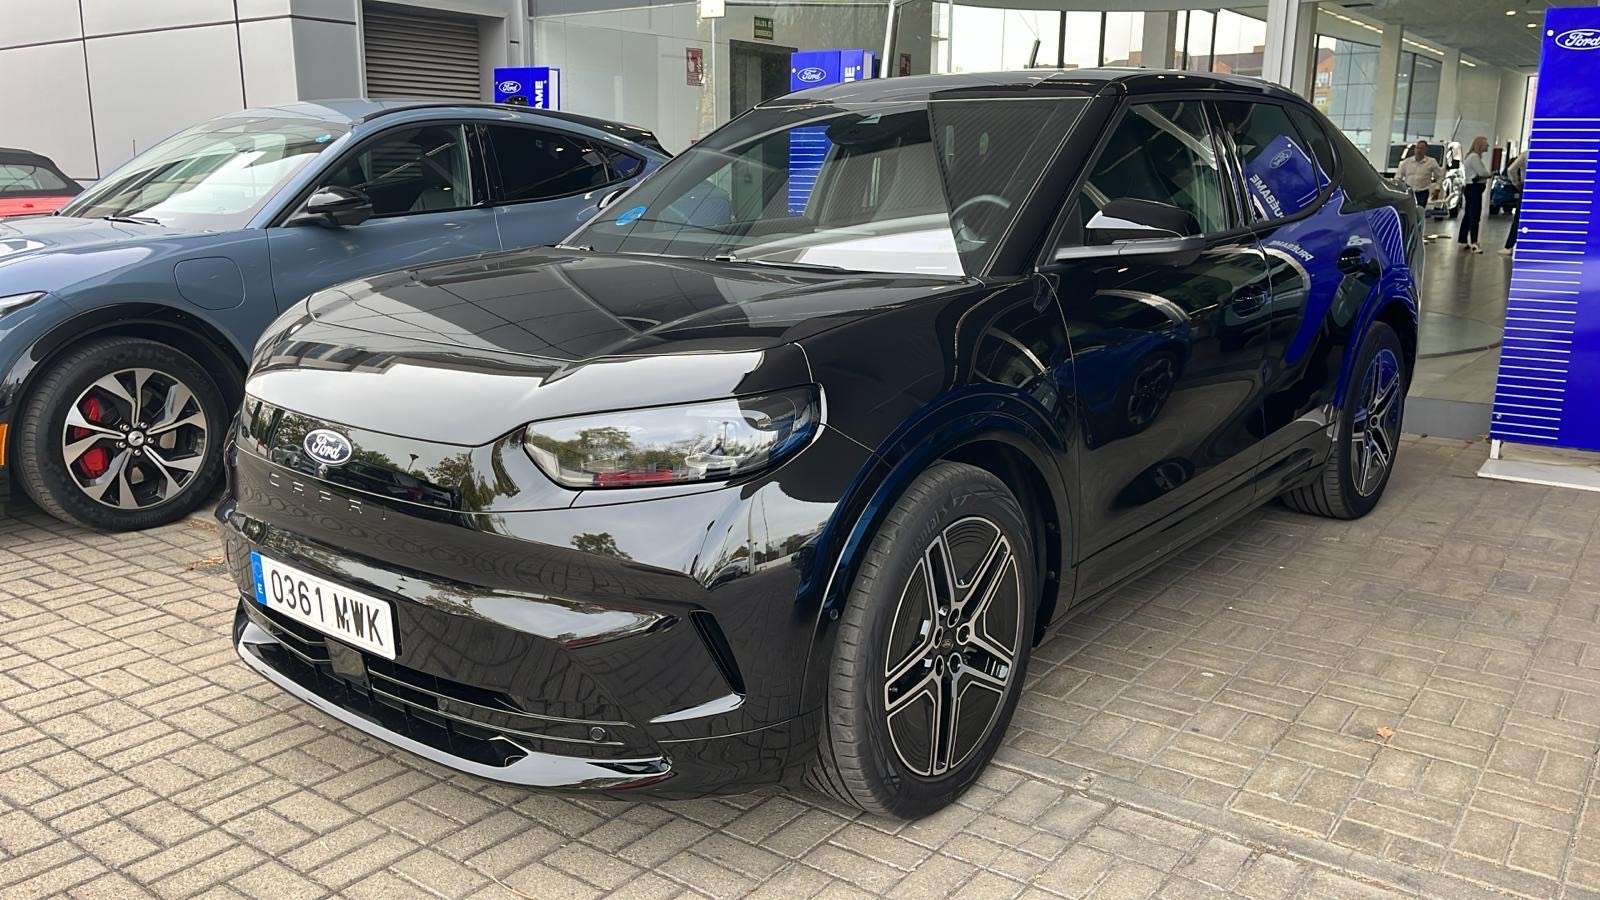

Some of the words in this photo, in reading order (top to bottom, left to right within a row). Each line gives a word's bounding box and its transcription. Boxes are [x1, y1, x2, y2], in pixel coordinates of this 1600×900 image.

[801, 69, 822, 80] Ford
[311, 433, 342, 460] Ford
[271, 569, 324, 622] 0361
[334, 593, 383, 646] MWK
